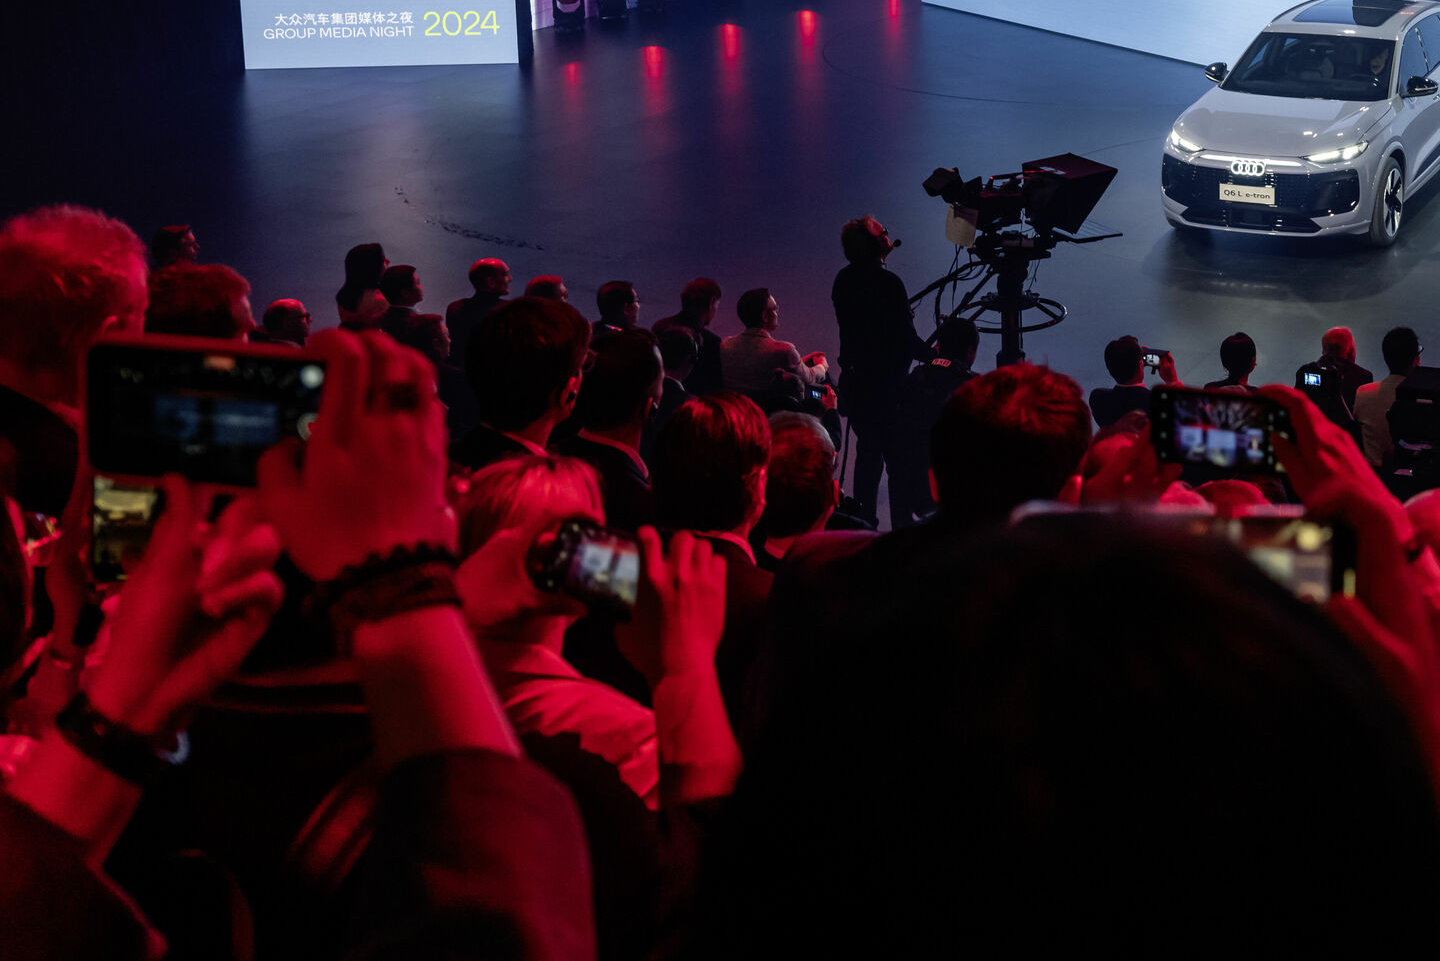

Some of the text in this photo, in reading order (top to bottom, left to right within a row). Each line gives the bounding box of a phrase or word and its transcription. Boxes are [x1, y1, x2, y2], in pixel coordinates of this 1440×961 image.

[274, 11, 414, 27] 大众汽车集团媒体之夜
[423, 10, 500, 36] 2024
[263, 24, 414, 40] GROUP MEDIA NIGHT
